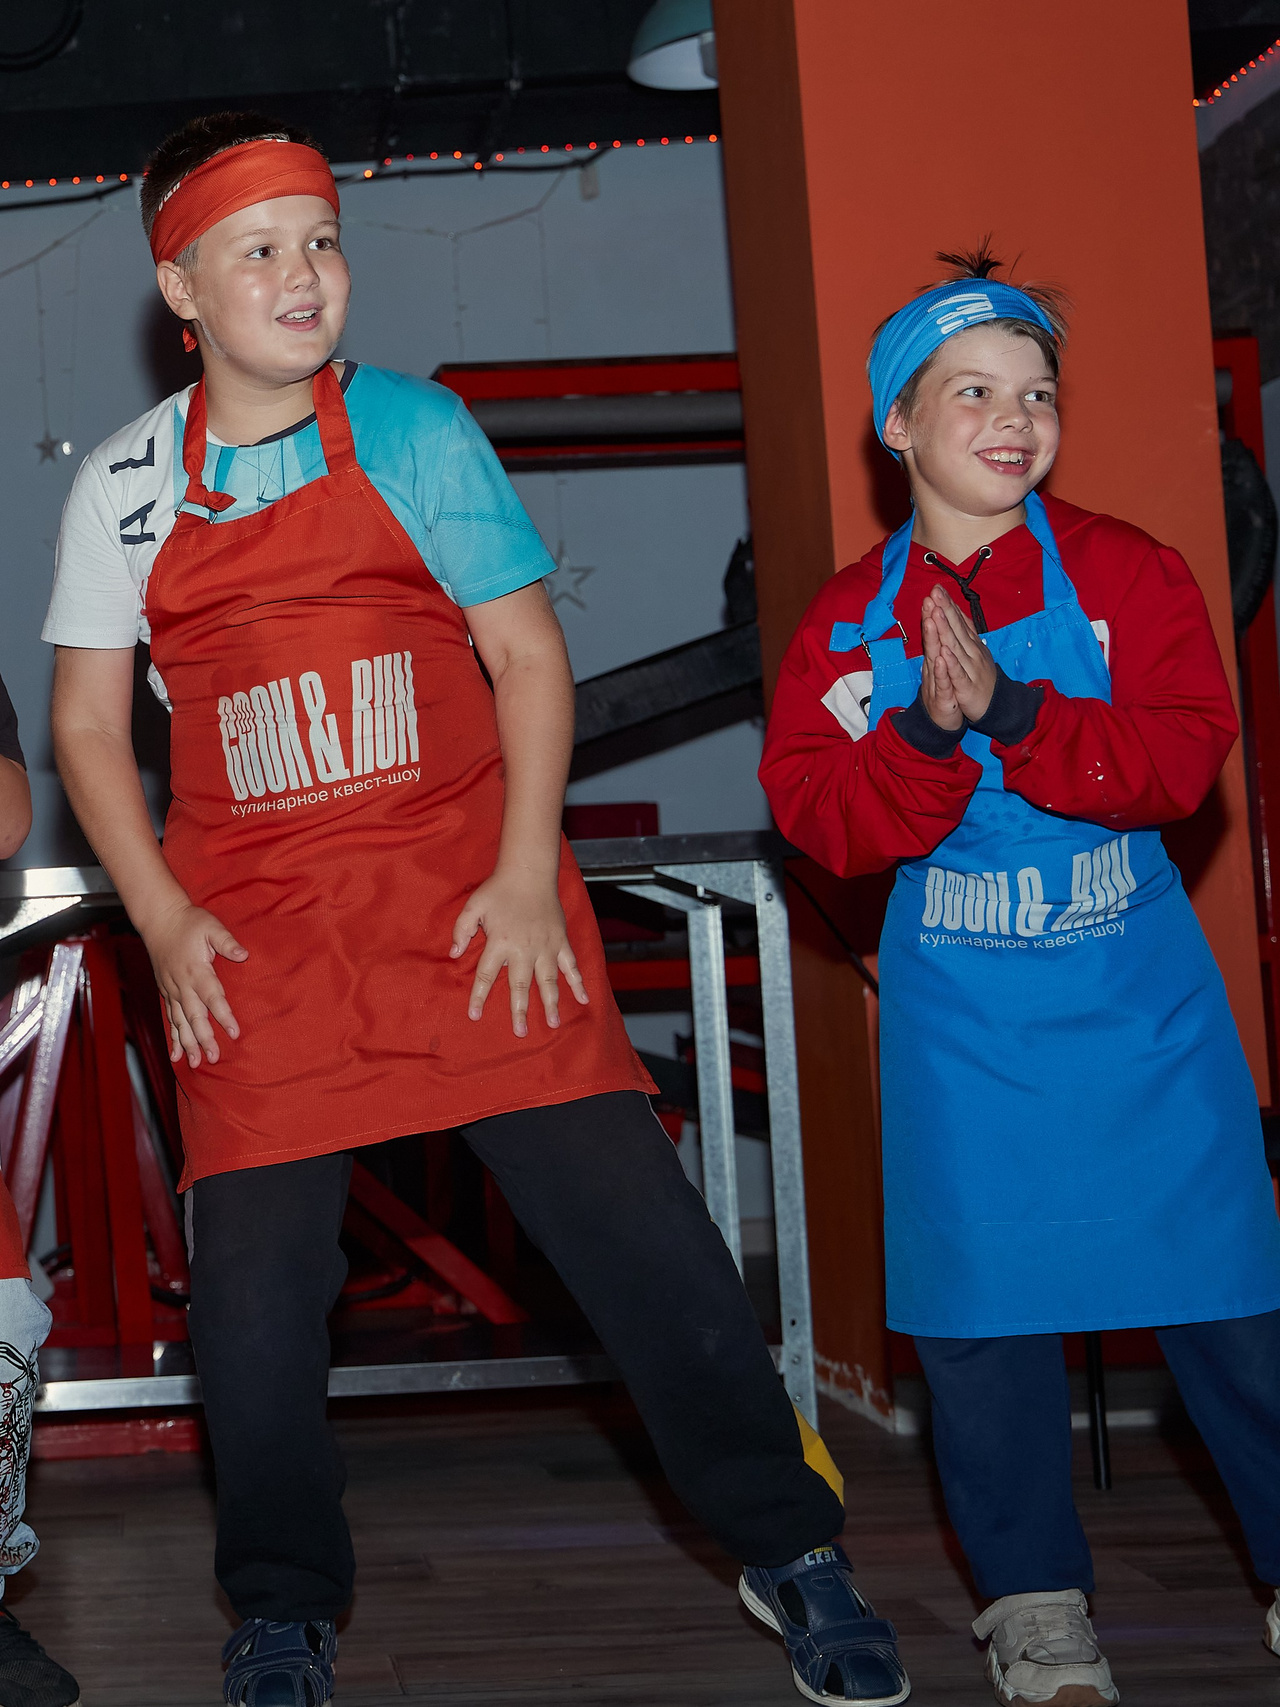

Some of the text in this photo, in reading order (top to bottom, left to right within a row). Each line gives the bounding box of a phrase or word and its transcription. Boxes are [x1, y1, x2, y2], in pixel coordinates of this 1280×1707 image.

[217, 650, 420, 801] COOK & RUN
[231, 767, 421, 818] кулинарное квест-шоу
[922, 834, 1137, 937] COOK & RUN
[920, 920, 1125, 950] кулинарное квест-шоу
